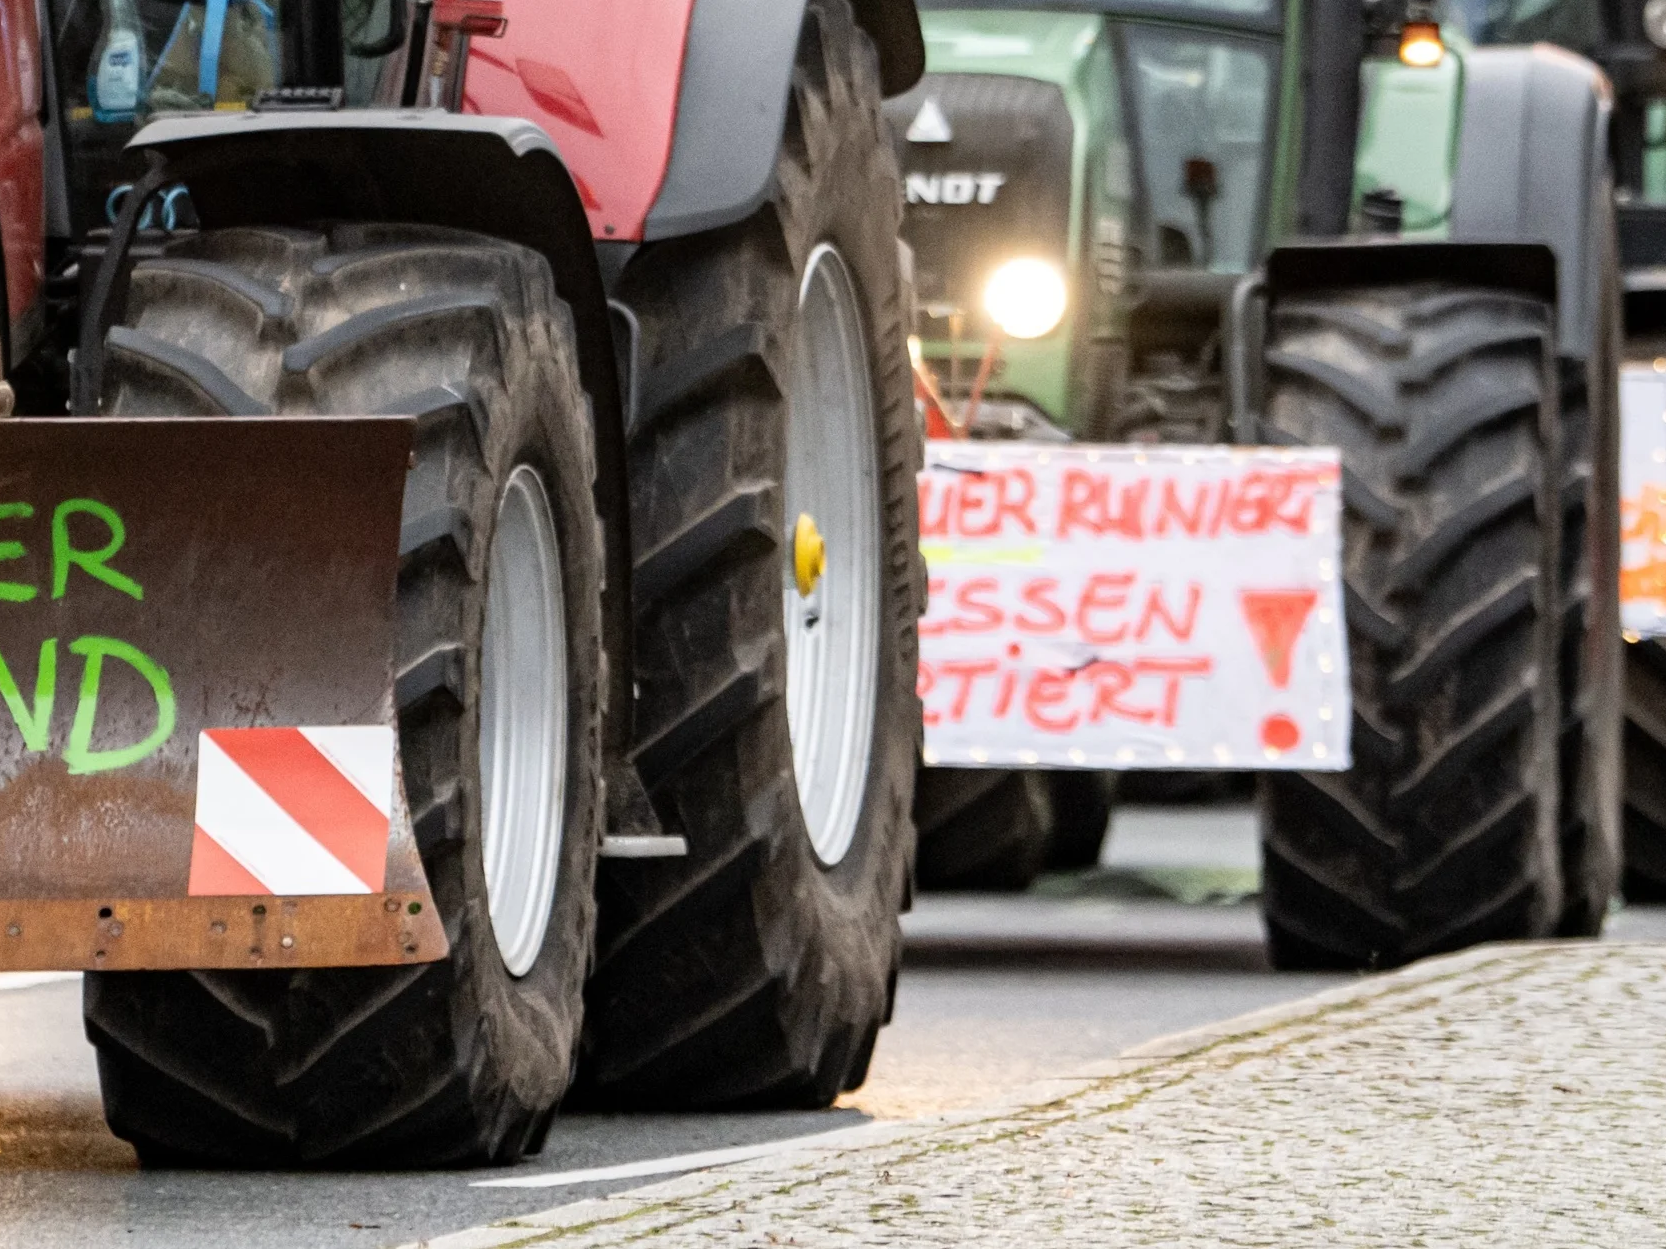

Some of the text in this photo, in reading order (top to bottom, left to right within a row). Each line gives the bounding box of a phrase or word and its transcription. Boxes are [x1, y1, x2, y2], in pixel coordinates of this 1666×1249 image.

[905, 172, 1006, 204] NDT
[918, 468, 1037, 539] UER
[916, 643, 1212, 733] TiERT
